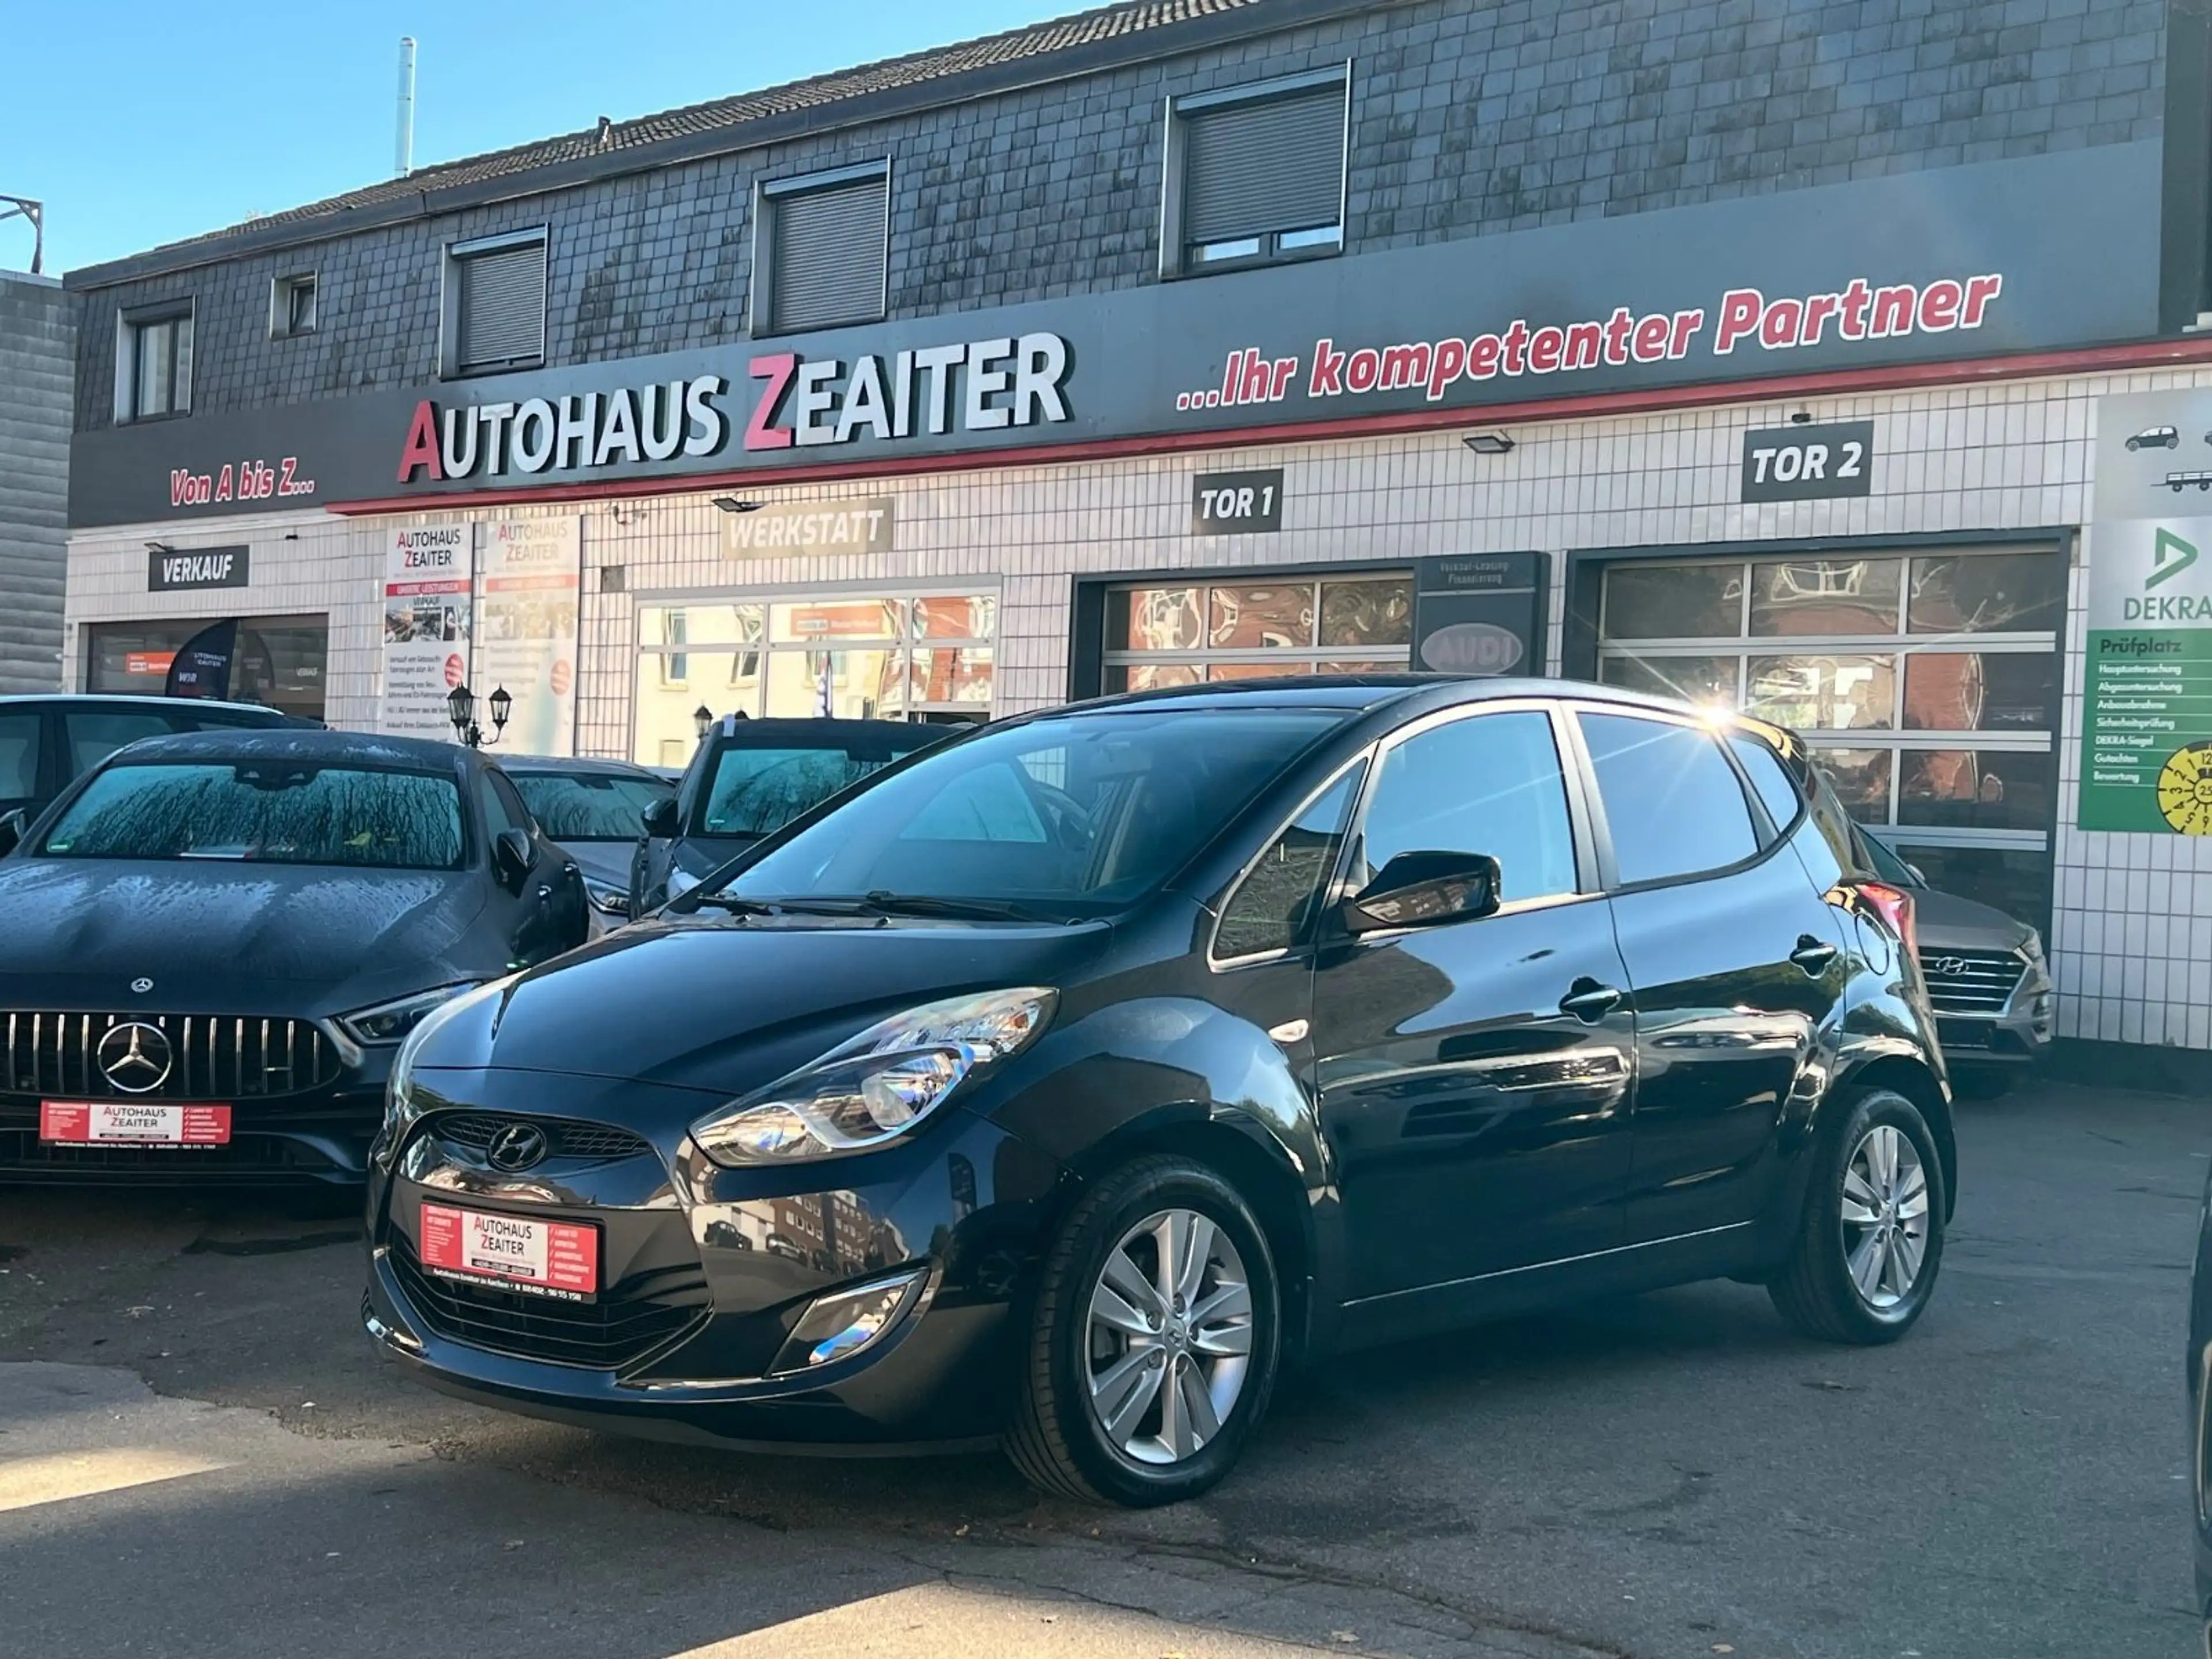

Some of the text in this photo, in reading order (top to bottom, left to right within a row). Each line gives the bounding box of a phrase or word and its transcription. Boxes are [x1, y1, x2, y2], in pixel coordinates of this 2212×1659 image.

[1308, 307, 1703, 402] kompetenter
[1713, 274, 2002, 355] Partner
[397, 332, 1066, 483] AUTOHAUS ZEAITER
[1752, 441, 1862, 483] TOR 2
[171, 457, 315, 506] Von A bis Z...
[1201, 486, 1274, 520] TOR 1
[397, 529, 461, 548] AUTOHAUS
[498, 521, 568, 541] AUTOHAUS
[729, 509, 884, 548] WERKSTATT
[405, 550, 452, 568] ZEAITER
[506, 542, 559, 562] ZEAITER
[163, 554, 233, 583] VERKAUF
[2124, 596, 2212, 620] DEKRA
[1435, 635, 1512, 666] AUDI
[2100, 637, 2182, 657] Prüfplatz
[2094, 753, 2138, 763] Gutachten
[104, 1107, 166, 1118] AUTOHAUS
[111, 1118, 157, 1127] ZEAITER
[474, 1215, 532, 1239] AUTOHAUS
[481, 1233, 524, 1256] ZEAITER
